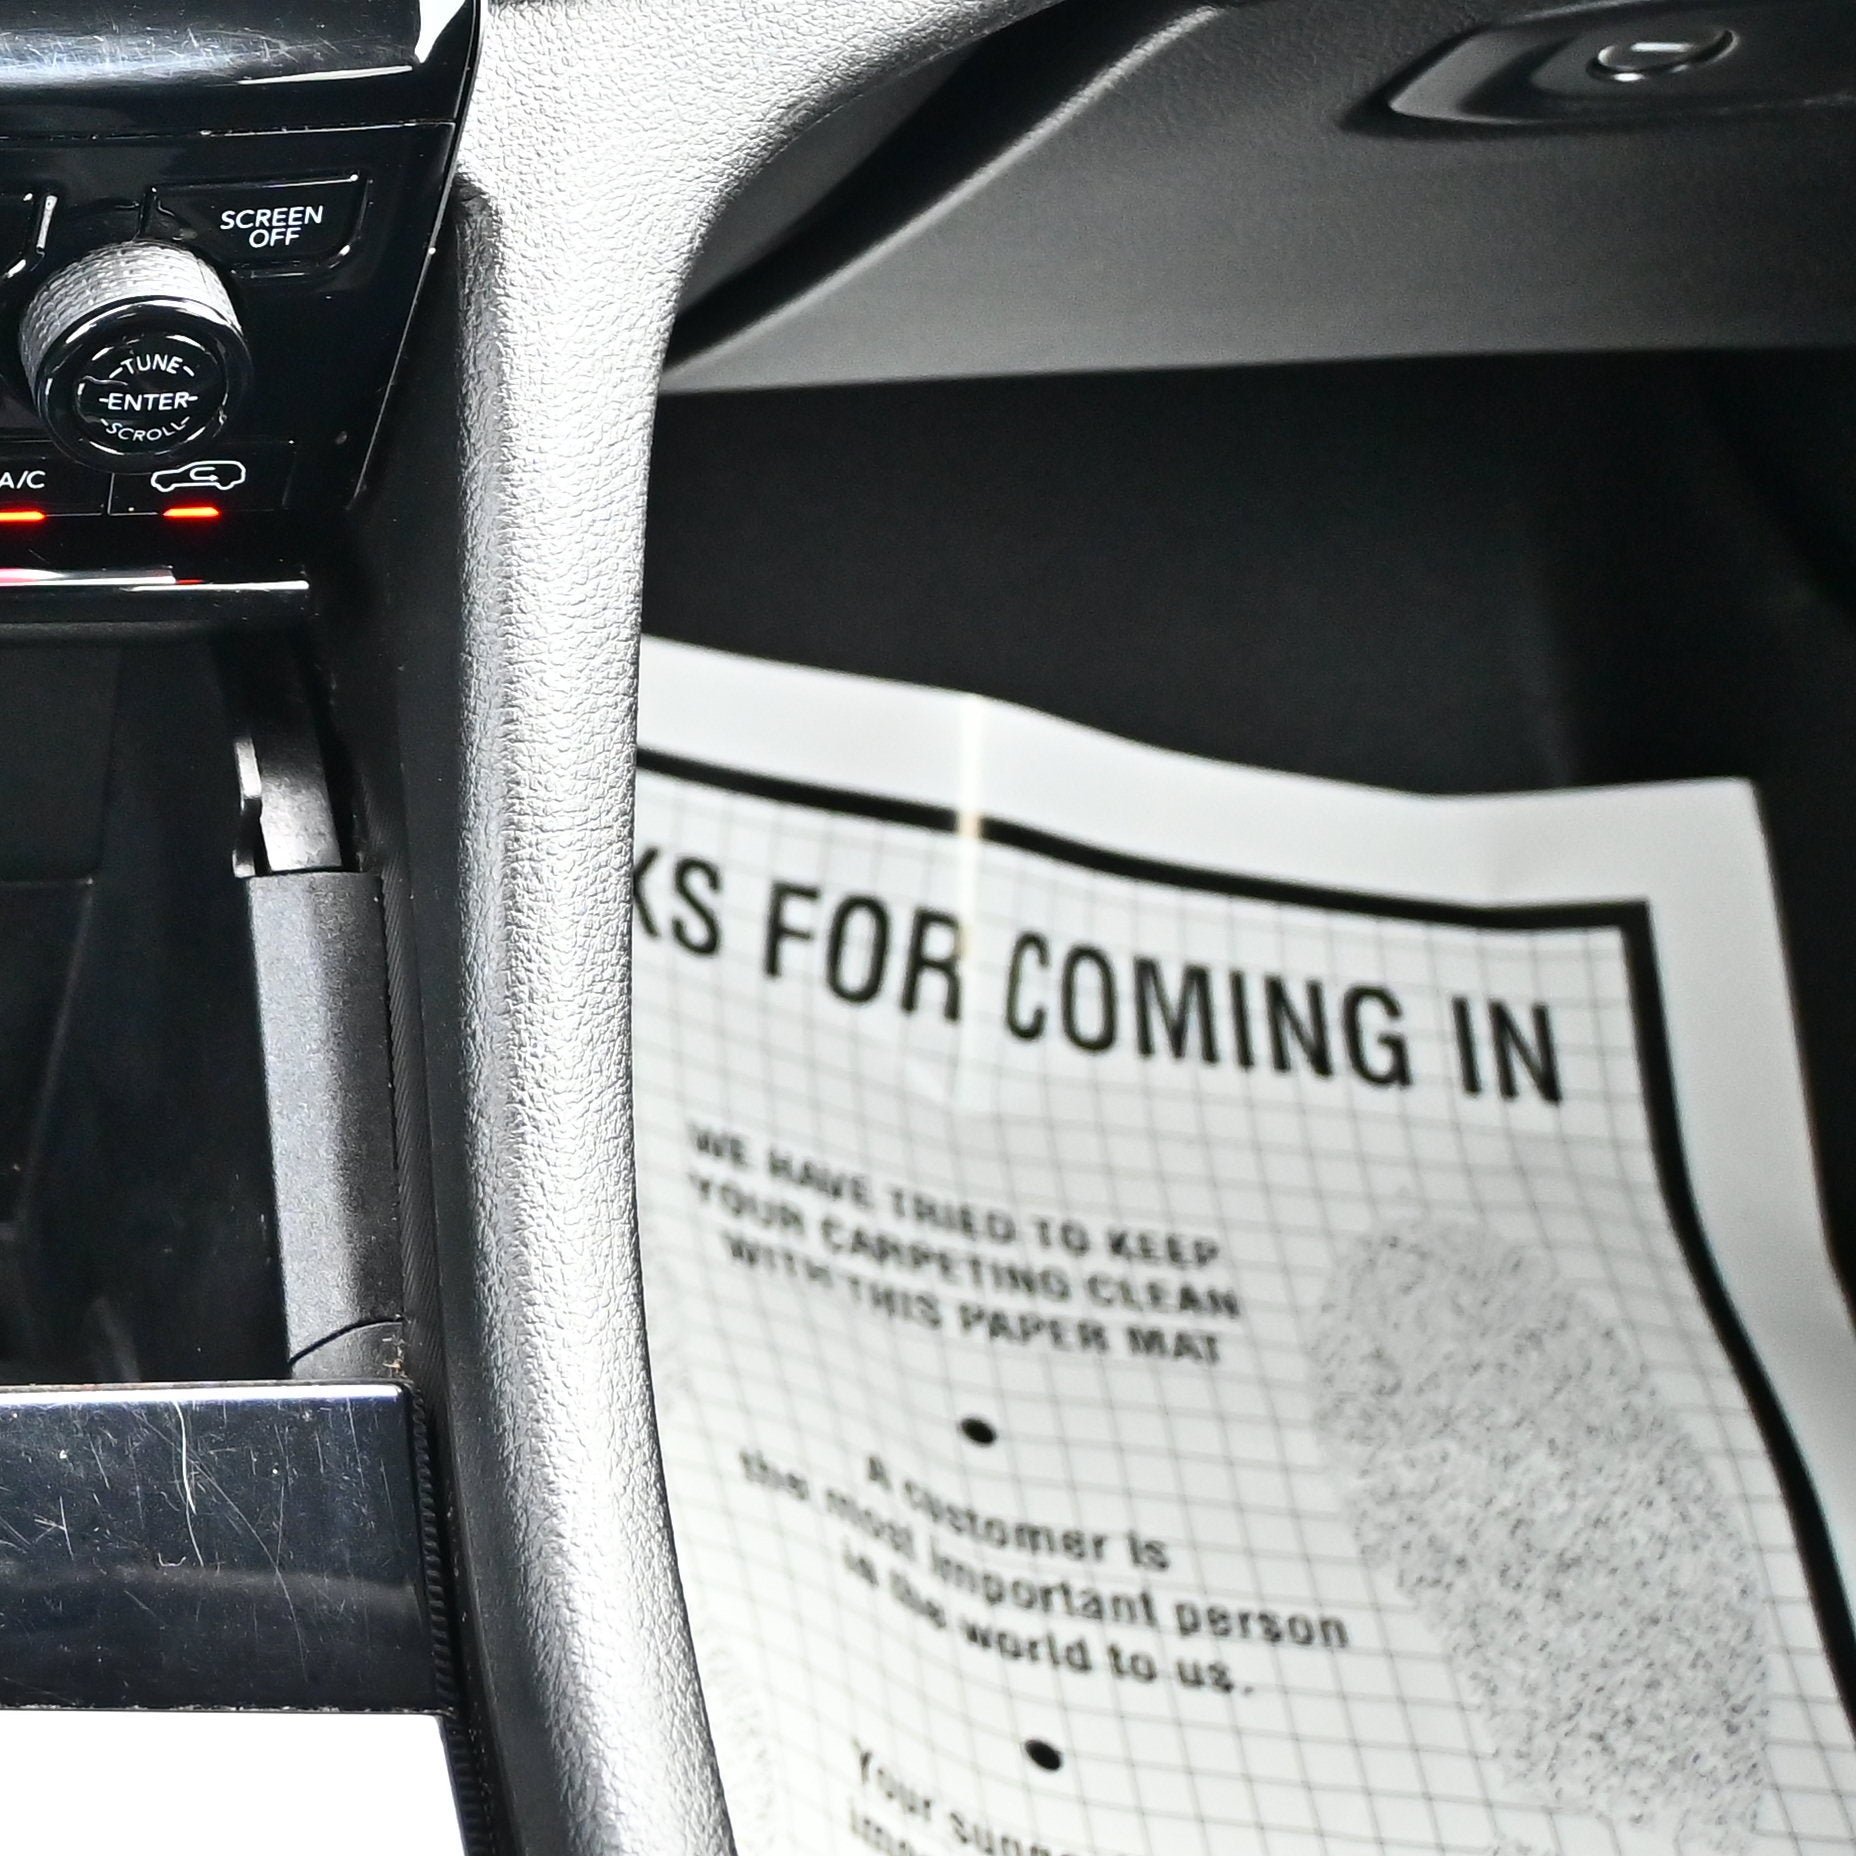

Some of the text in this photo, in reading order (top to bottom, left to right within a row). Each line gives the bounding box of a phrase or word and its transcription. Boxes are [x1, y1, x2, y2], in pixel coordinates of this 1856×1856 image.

[220, 206, 323, 230] SCREEN
[248, 227, 300, 249] OFF
[120, 353, 184, 376] TUNE
[105, 421, 185, 443] SCROLL
[764, 883, 966, 1022] FOR
[1005, 932, 1411, 1090] COMING
[1452, 995, 1561, 1105] IN
[689, 1125, 1220, 1267] WE HAVE TRIED TO KEEP
[689, 1171, 1240, 1319] YOUR CARPETING CLEAN
[722, 1230, 1222, 1365] WITH THIS PAPER MAT
[739, 1451, 810, 1501] the
[929, 1547, 1159, 1627] important
[1174, 1602, 1349, 1648] person
[868, 1456, 1171, 1572] A customer is
[890, 1571, 947, 1630] the
[961, 1621, 1092, 1674] world
[1109, 1644, 1157, 1684] to
[1177, 1659, 1255, 1696] us.
